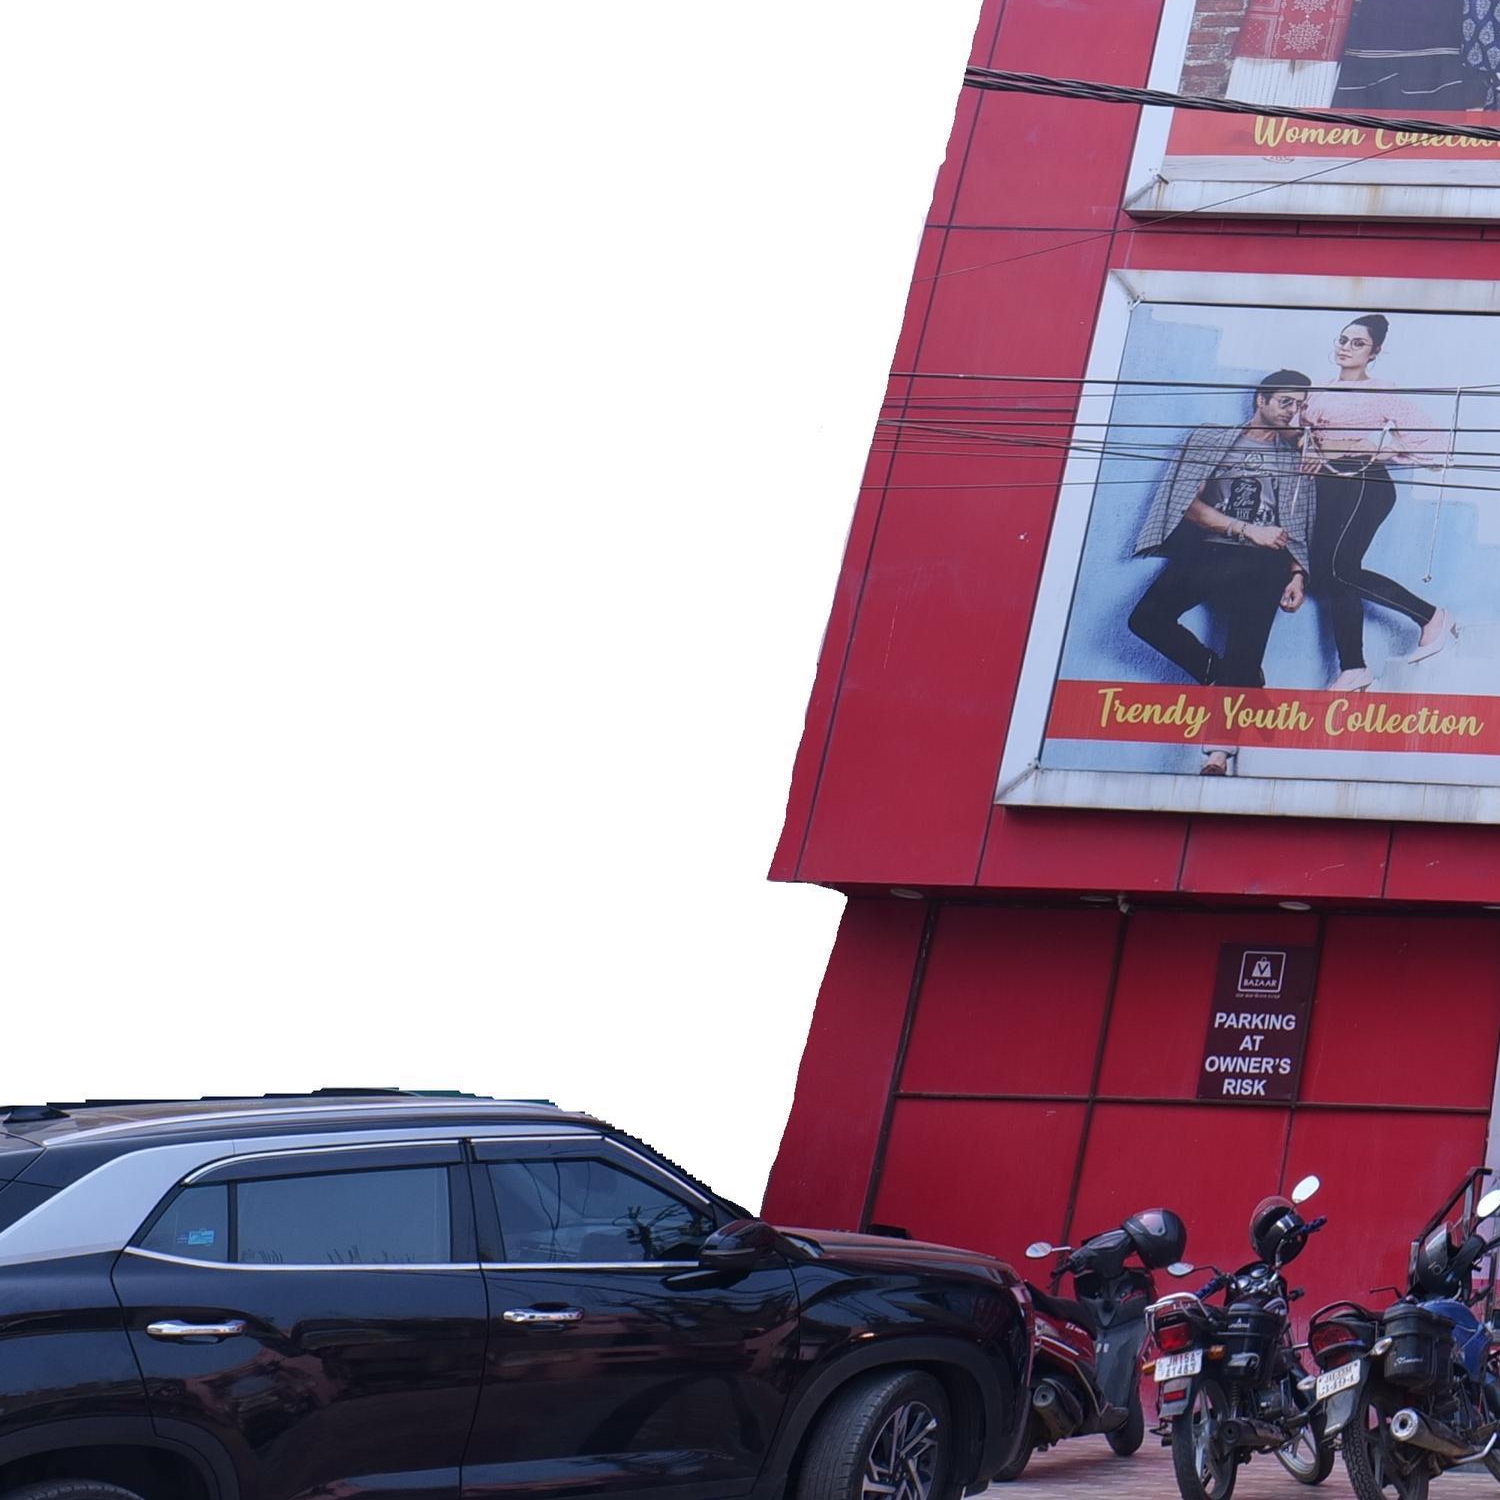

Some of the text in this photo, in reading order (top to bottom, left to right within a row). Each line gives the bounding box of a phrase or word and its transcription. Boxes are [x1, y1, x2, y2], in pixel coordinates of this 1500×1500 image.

[1254, 115, 1365, 147] Women
[1098, 688, 1484, 739] Trendy Youth Collection
[1243, 979, 1278, 987] BAZAAR
[1214, 1012, 1296, 1030] PARKING
[1239, 1035, 1264, 1051] AT
[1205, 1056, 1291, 1074] OWNER'S
[1222, 1078, 1266, 1095] RISK
